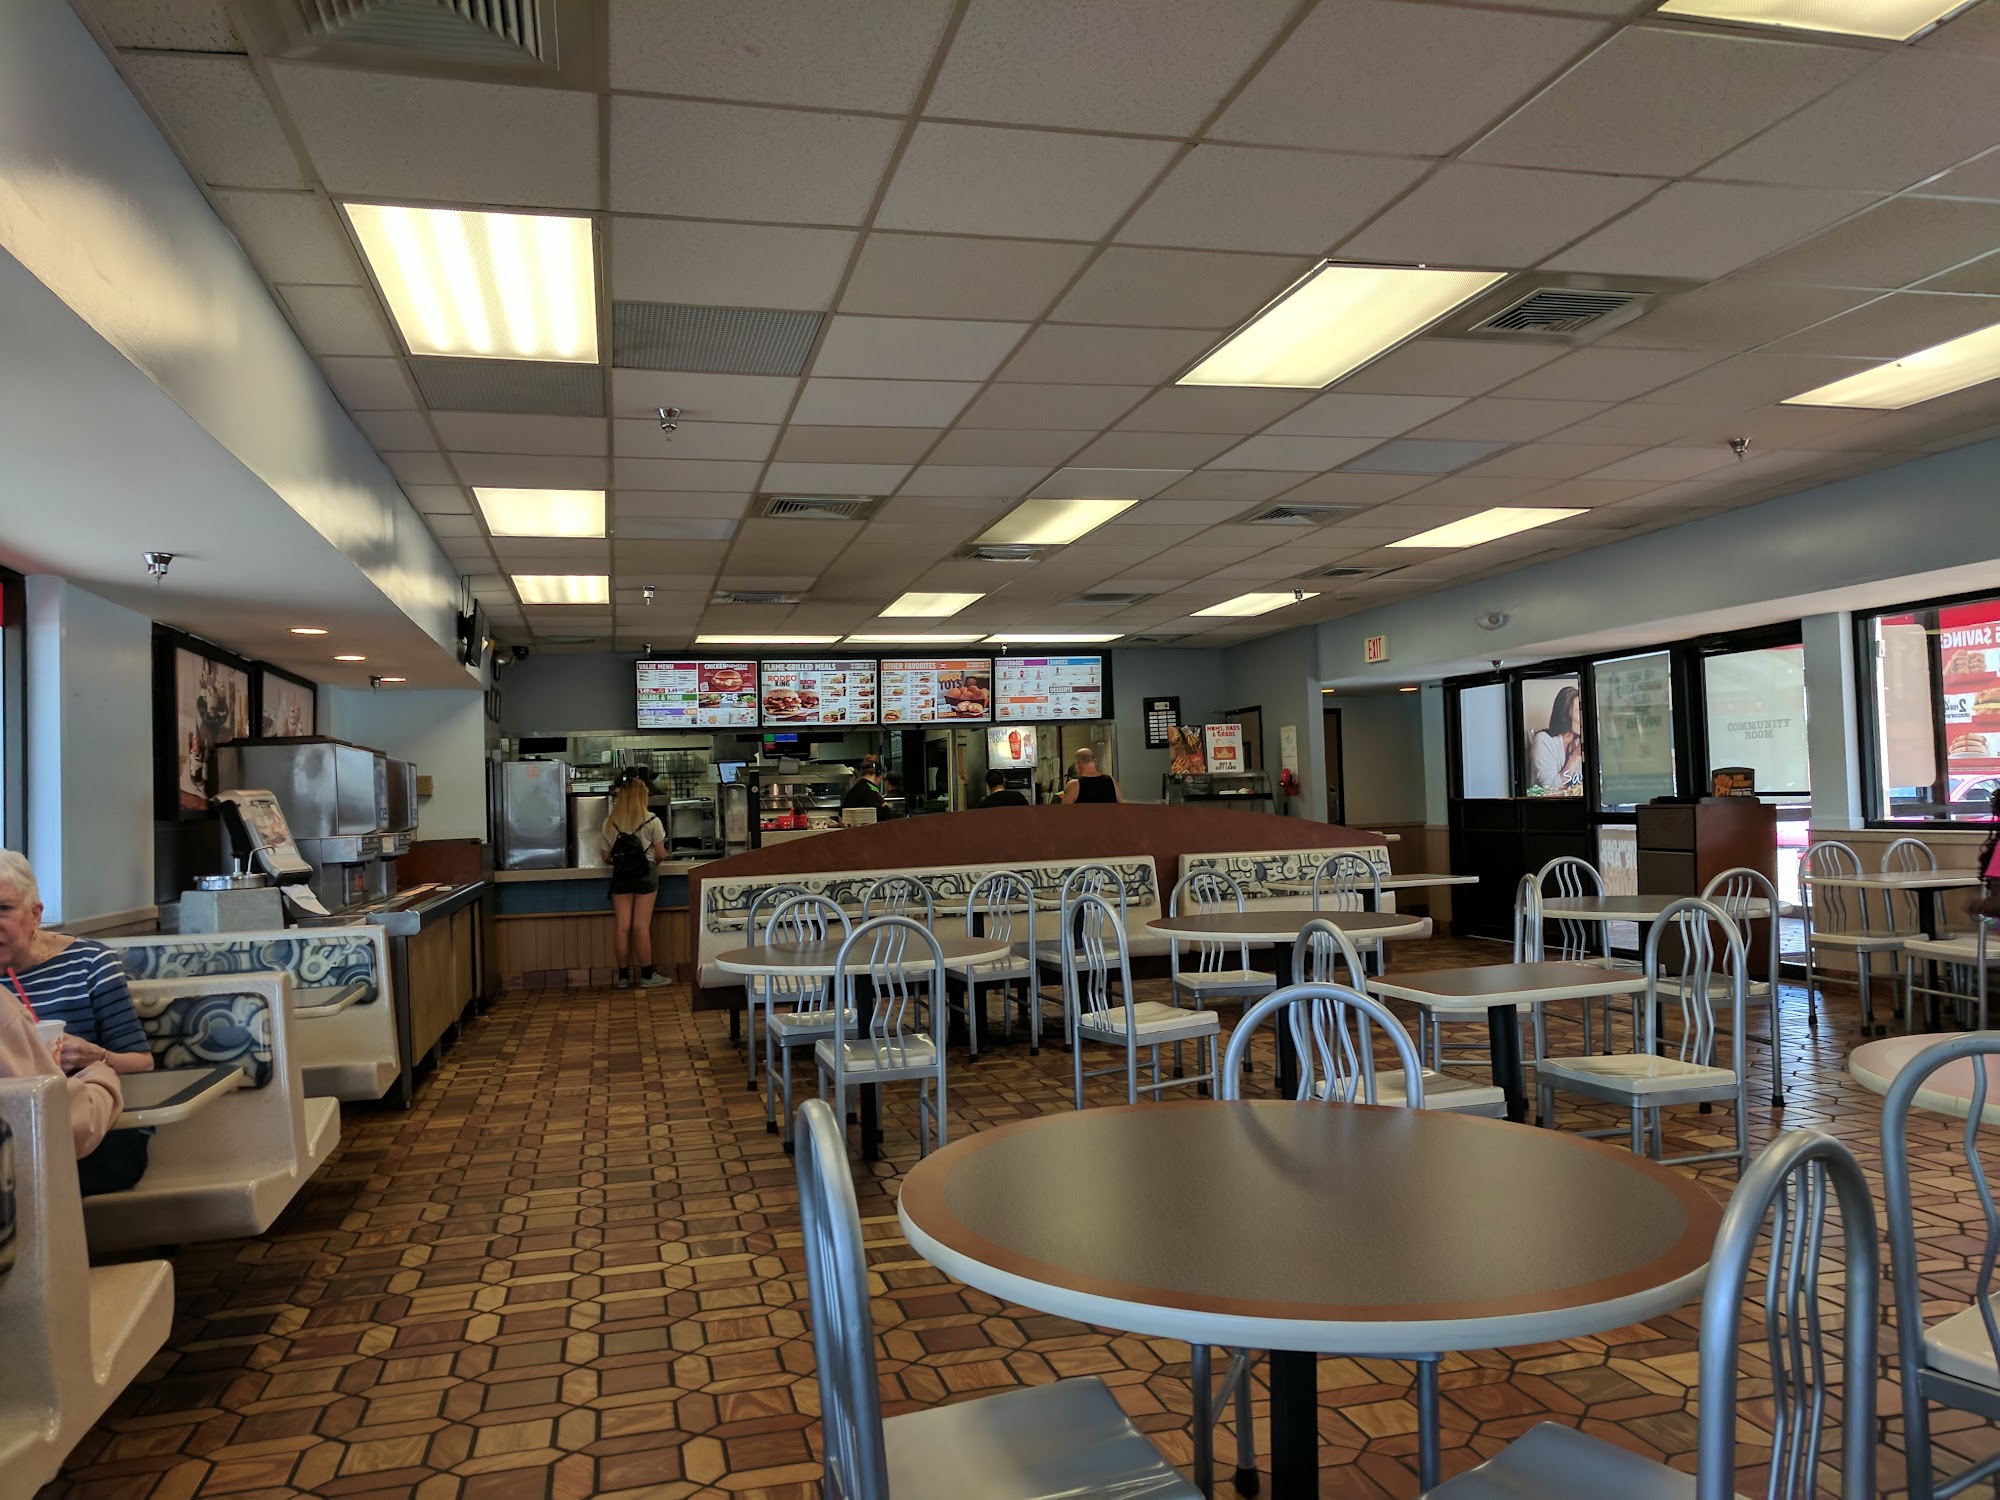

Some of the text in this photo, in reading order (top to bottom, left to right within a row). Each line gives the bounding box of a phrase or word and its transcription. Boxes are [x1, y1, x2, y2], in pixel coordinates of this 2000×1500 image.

[1368, 638, 1381, 660] EXIT
[764, 663, 813, 671] FLAME-GRILLED
[883, 662, 903, 670] OTHER
[904, 662, 936, 670] FAVORITES
[721, 693, 728, 701] 2
[1727, 718, 1791, 732] COMMUNITY
[1744, 730, 1774, 740] ROOM
[1562, 769, 1583, 785] Sa
